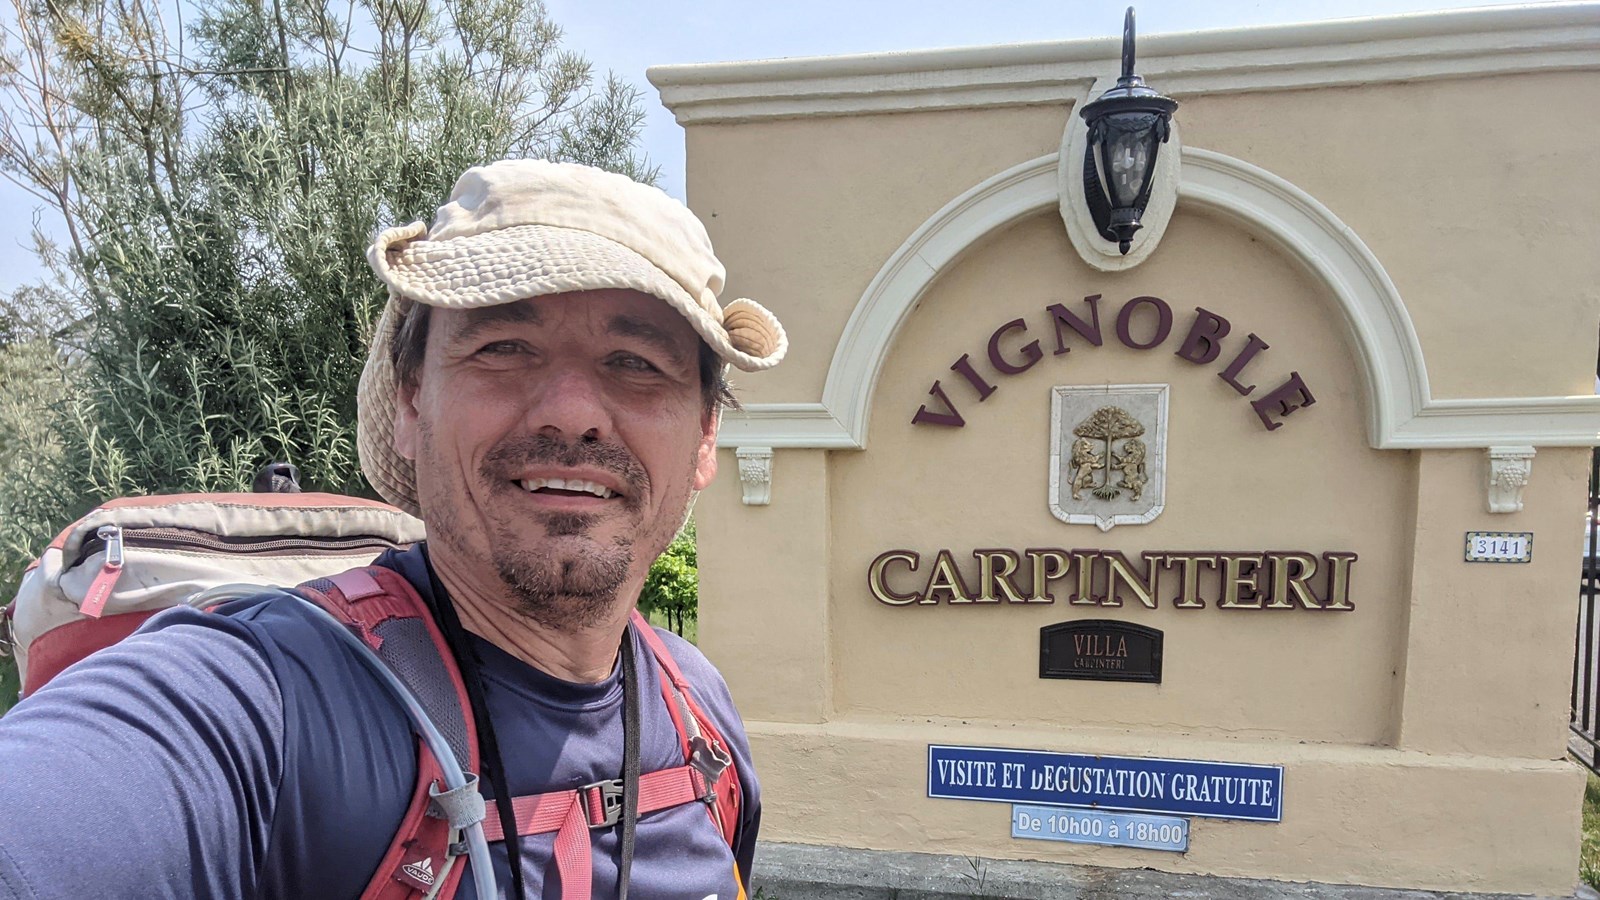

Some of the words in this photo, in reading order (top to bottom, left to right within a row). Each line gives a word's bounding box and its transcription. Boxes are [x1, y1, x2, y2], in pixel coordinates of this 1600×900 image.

[911, 294, 1316, 431] VIGNOBLE
[1477, 539, 1519, 555] 3141
[867, 548, 1358, 611] CARPINTERI
[1073, 634, 1128, 657] VILLA
[937, 759, 997, 787] VISITE
[1002, 762, 1026, 789] ET
[1030, 765, 1166, 799] DEGUSTATION
[1171, 773, 1273, 807] GRATUITE
[1017, 812, 1042, 832] De
[1048, 815, 1103, 837] 10h00
[1108, 820, 1120, 839] à
[1126, 821, 1182, 844] 18h00
